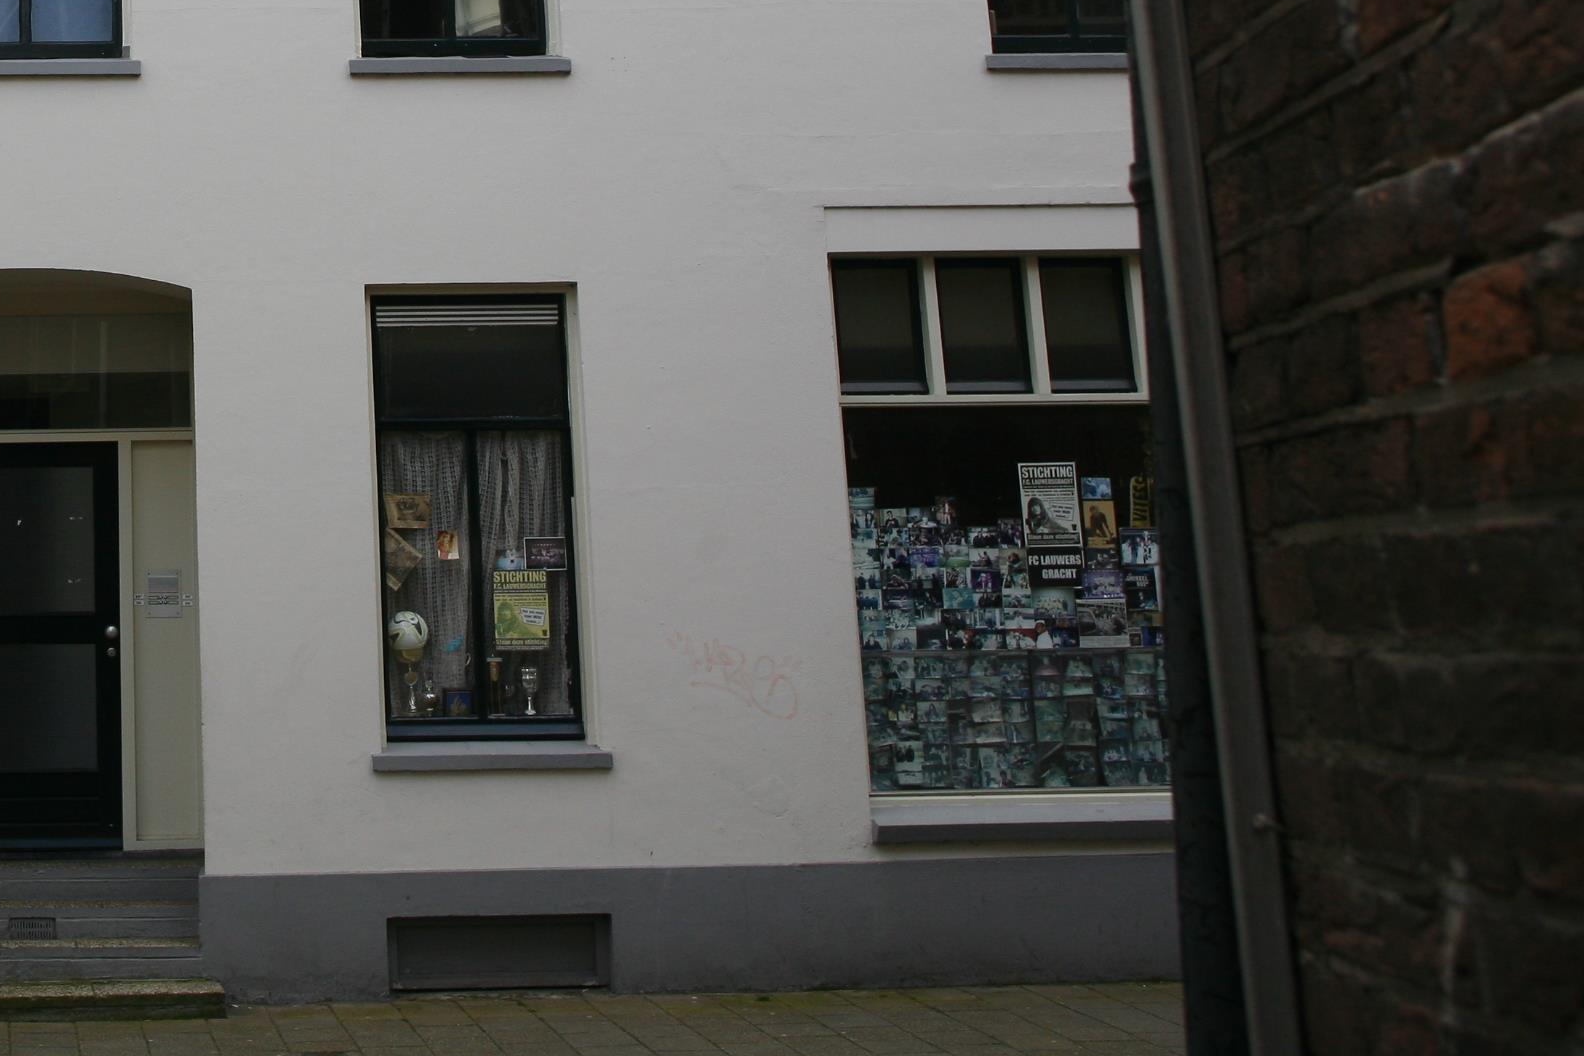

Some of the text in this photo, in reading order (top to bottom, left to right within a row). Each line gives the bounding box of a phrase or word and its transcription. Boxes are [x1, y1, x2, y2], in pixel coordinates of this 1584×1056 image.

[1022, 466, 1073, 478] STICHTING
[1028, 555, 1081, 565] FC LAUWERS
[493, 571, 547, 583] STICHTING
[1042, 568, 1077, 579] GRACHT
